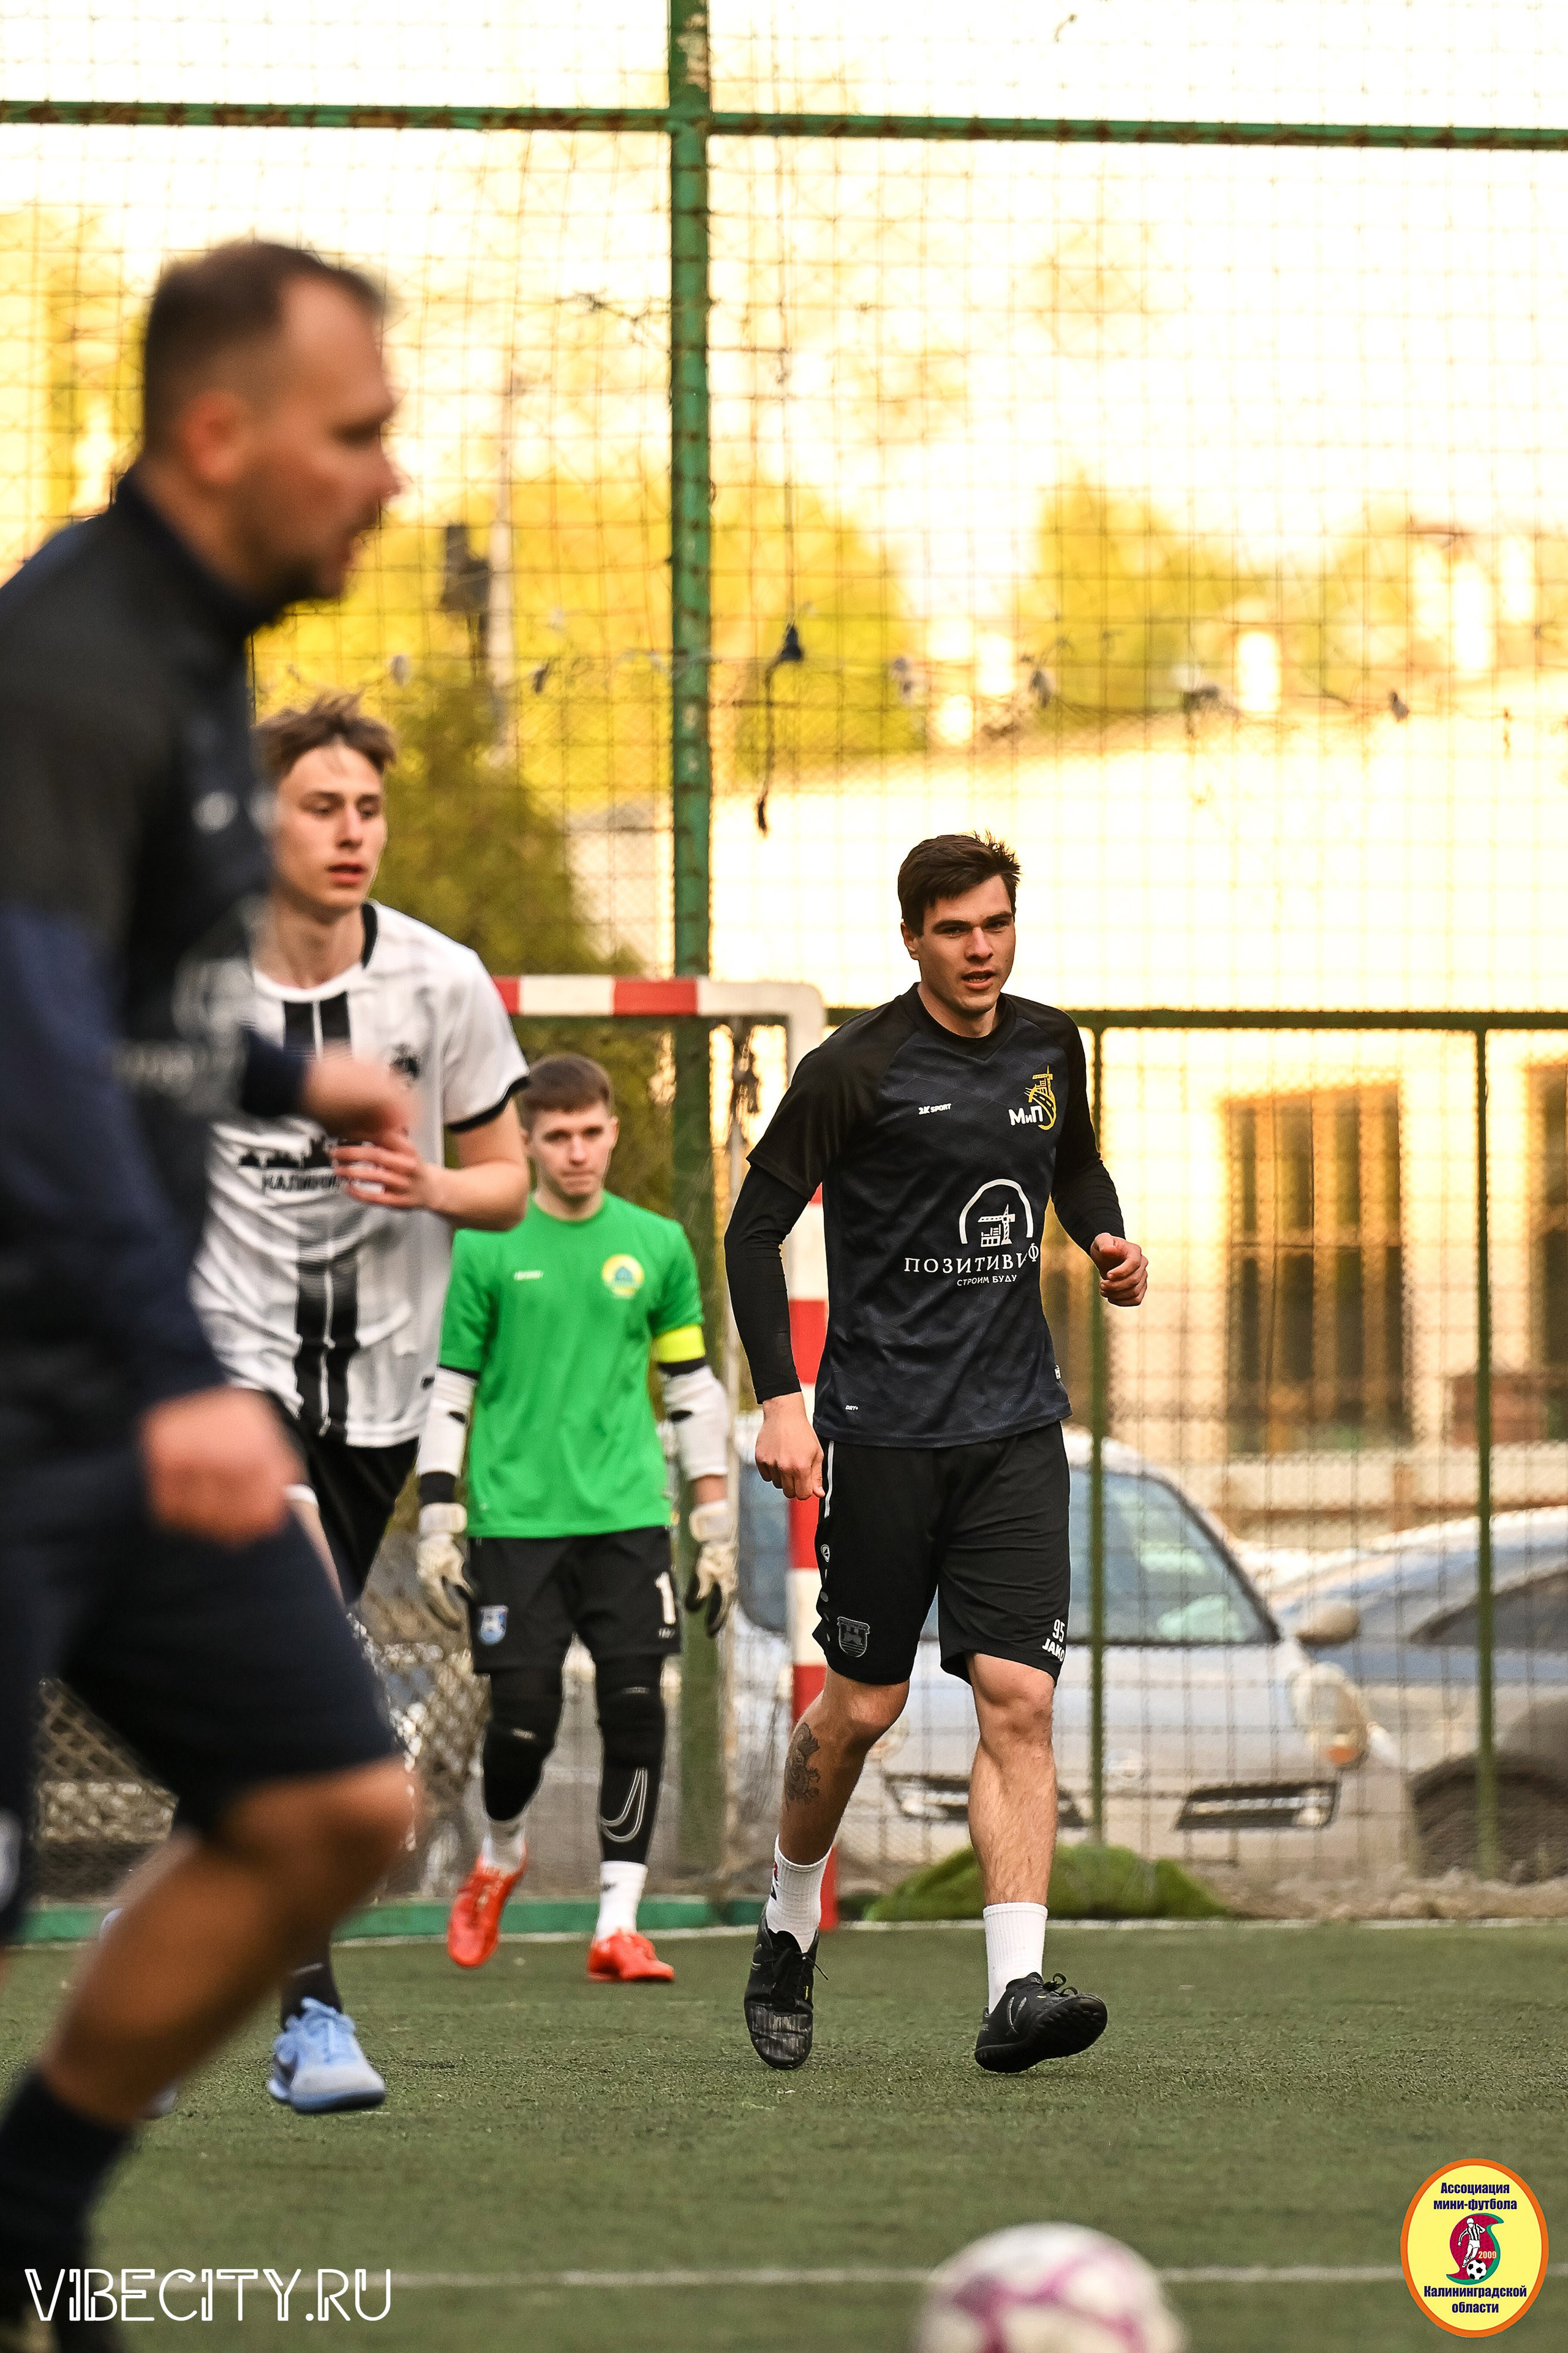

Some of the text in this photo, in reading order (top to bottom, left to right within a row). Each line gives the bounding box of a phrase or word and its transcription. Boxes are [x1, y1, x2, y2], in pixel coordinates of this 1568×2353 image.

[919, 1103, 952, 1115] 2K SPORT
[1008, 1105, 1043, 1126] МиП
[957, 1276, 990, 1286] СТРОИМ
[654, 1571, 676, 1625] 1
[1052, 1619, 1065, 1643] 95
[1042, 1638, 1065, 1662] JAKO
